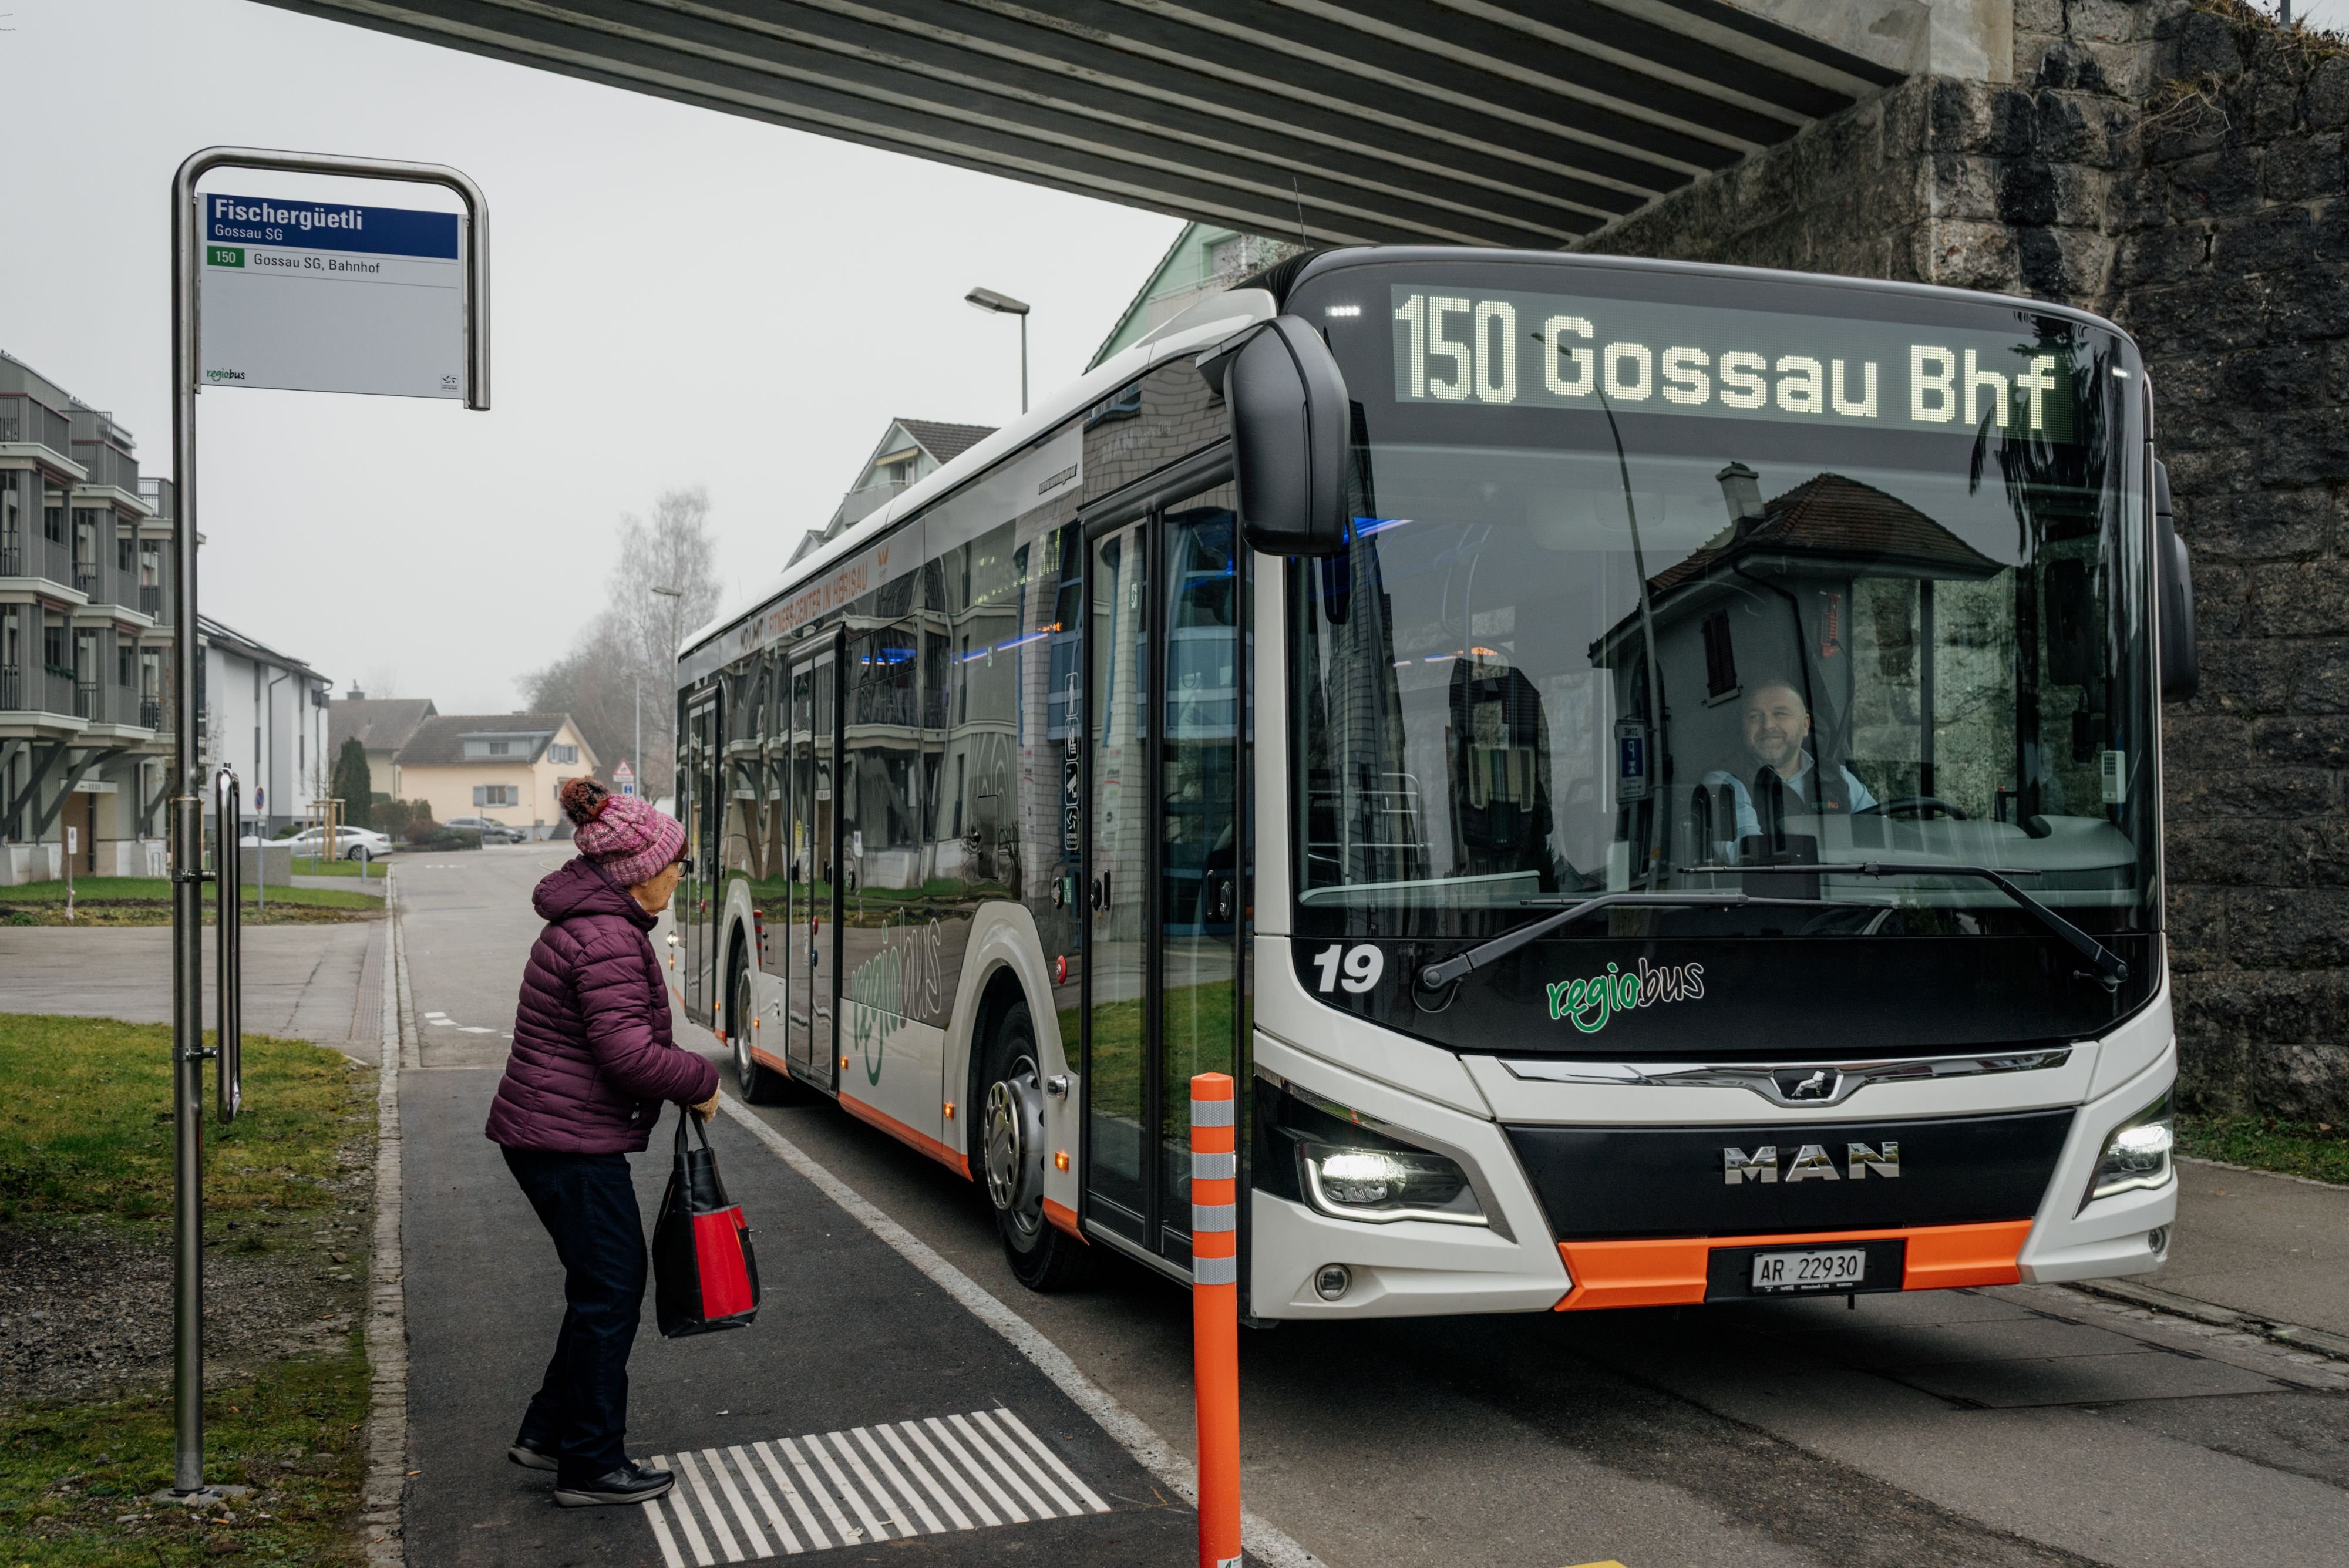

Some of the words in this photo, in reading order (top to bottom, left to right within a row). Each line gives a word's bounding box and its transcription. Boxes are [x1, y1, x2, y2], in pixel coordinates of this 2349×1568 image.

[215, 198, 362, 230] Fischergüetli
[215, 224, 261, 239] Gossau
[265, 228, 282, 240] SG
[216, 250, 235, 263] 150
[254, 253, 299, 267] Gossau
[304, 257, 324, 271] SG,
[329, 259, 380, 273] Bahnhof
[207, 368, 245, 382] regiobus
[1395, 294, 1516, 404] 150
[1546, 315, 1877, 418] Gossau
[1911, 344, 2055, 430] Bhf
[823, 582, 831, 611] IN
[833, 560, 869, 605] HERISAU
[1314, 944, 1384, 993] 19
[852, 906, 941, 1086] regiobus
[1546, 957, 1704, 1034] regiobus
[1724, 1142, 1900, 1184] MAN
[1760, 1259, 1784, 1281] AR
[1798, 1255, 1857, 1280] 22930
